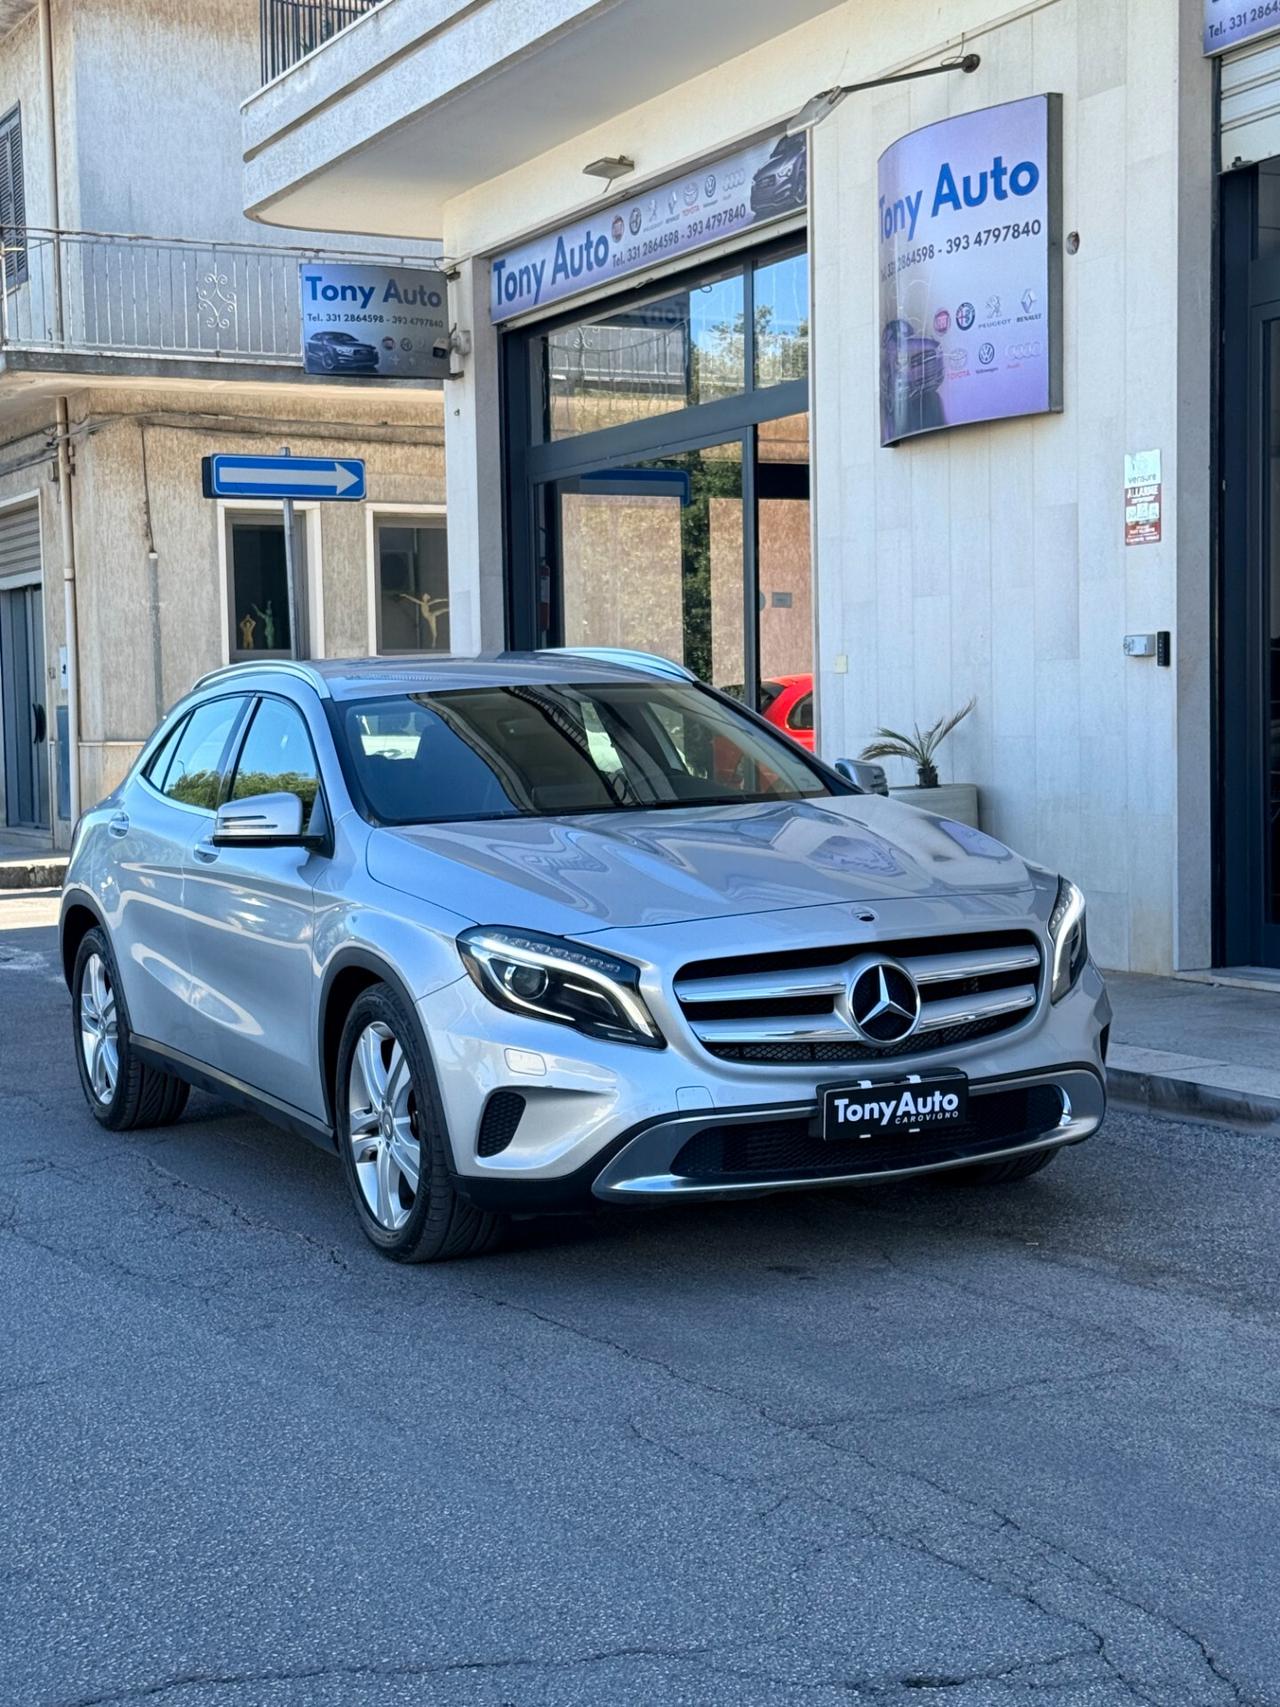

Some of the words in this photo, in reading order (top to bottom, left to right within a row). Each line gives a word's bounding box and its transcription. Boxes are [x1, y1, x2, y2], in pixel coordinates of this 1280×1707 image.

[1209, 21, 1226, 39] Tel.
[1229, 12, 1247, 30] 331
[1250, 0, 1280, 22] 2864
[879, 189, 923, 244] Tony
[930, 155, 1040, 218] Auto
[612, 251, 625, 268] Tel.
[627, 247, 640, 262] 331
[642, 230, 679, 257] 2864598
[687, 223, 703, 239] 393
[705, 203, 746, 230] 4797840
[946, 234, 970, 254] 393
[974, 219, 1042, 248] 4797840
[493, 258, 546, 306] Tony
[551, 231, 610, 285] Auto
[305, 276, 376, 309] Tony
[382, 278, 442, 308] Auto
[307, 313, 322, 322] Tel.
[326, 313, 341, 322] 331
[344, 313, 384, 324] 2864598
[978, 318, 1012, 329] PEUGEOT
[894, 1110, 959, 1125] CAROVIGNO
